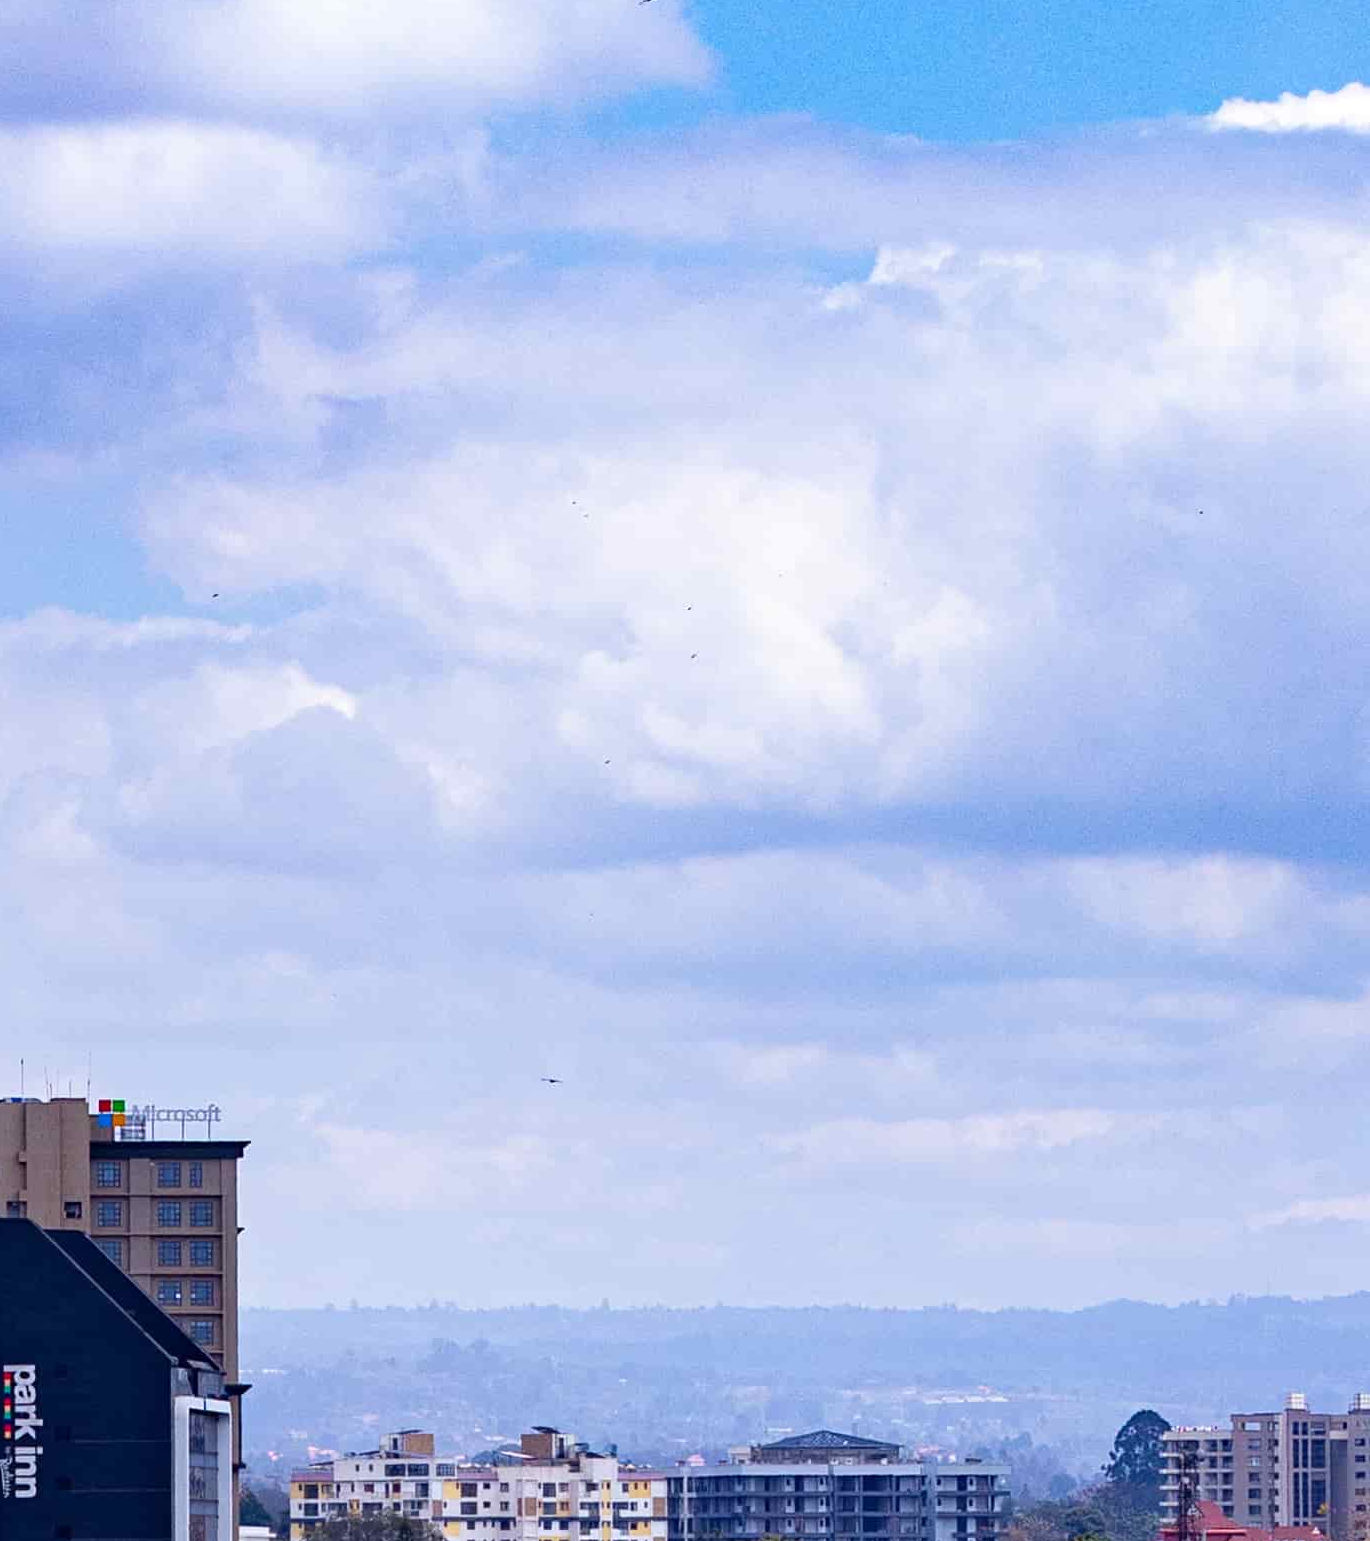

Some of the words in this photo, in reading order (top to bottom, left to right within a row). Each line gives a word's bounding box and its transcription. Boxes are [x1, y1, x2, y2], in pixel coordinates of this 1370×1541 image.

[130, 1103, 222, 1123] Microsoft
[3, 1364, 44, 1441] park
[14, 1446, 44, 1499] inn
